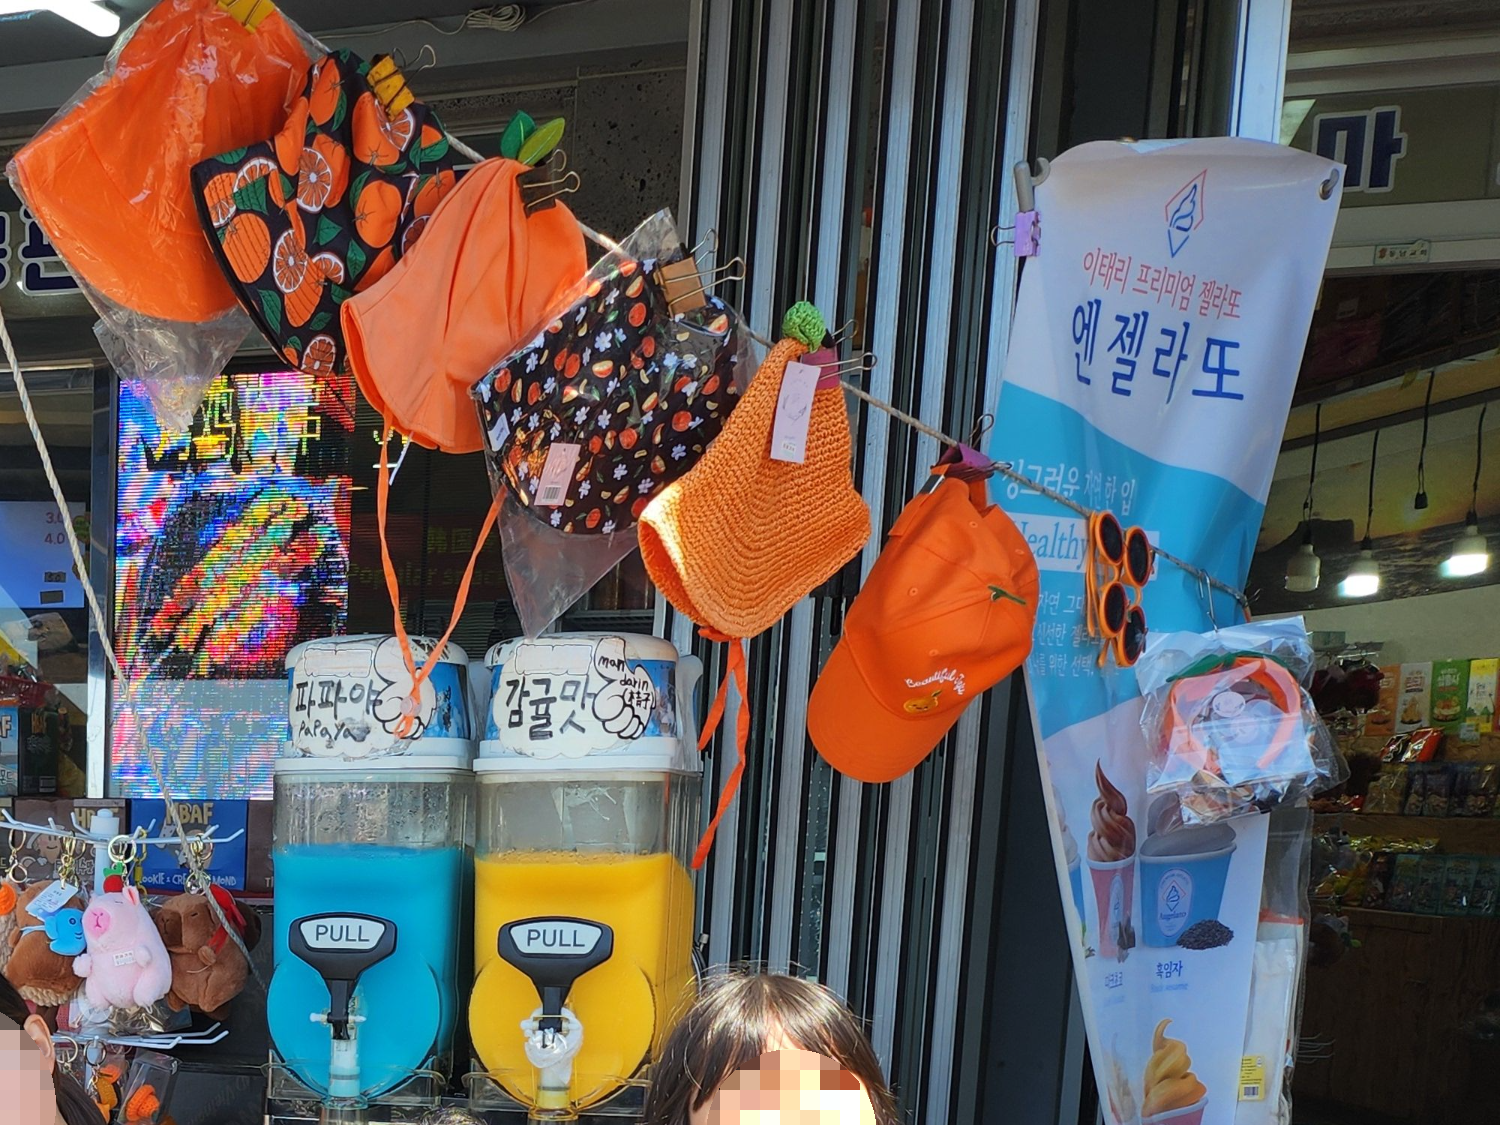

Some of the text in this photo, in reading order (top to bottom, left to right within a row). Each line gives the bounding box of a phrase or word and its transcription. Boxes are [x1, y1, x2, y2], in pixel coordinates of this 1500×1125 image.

[1083, 248, 1242, 320] 이태리 프리미엄 젤라또
[1072, 298, 1244, 404] 엔젤라또
[1104, 476, 1117, 511] 한
[1121, 479, 1136, 516] 입
[45, 532, 66, 545] 4.0
[296, 679, 383, 720] 파파야
[506, 674, 597, 741] 감귤맛
[315, 924, 370, 944] PULL
[526, 928, 586, 949] PULL
